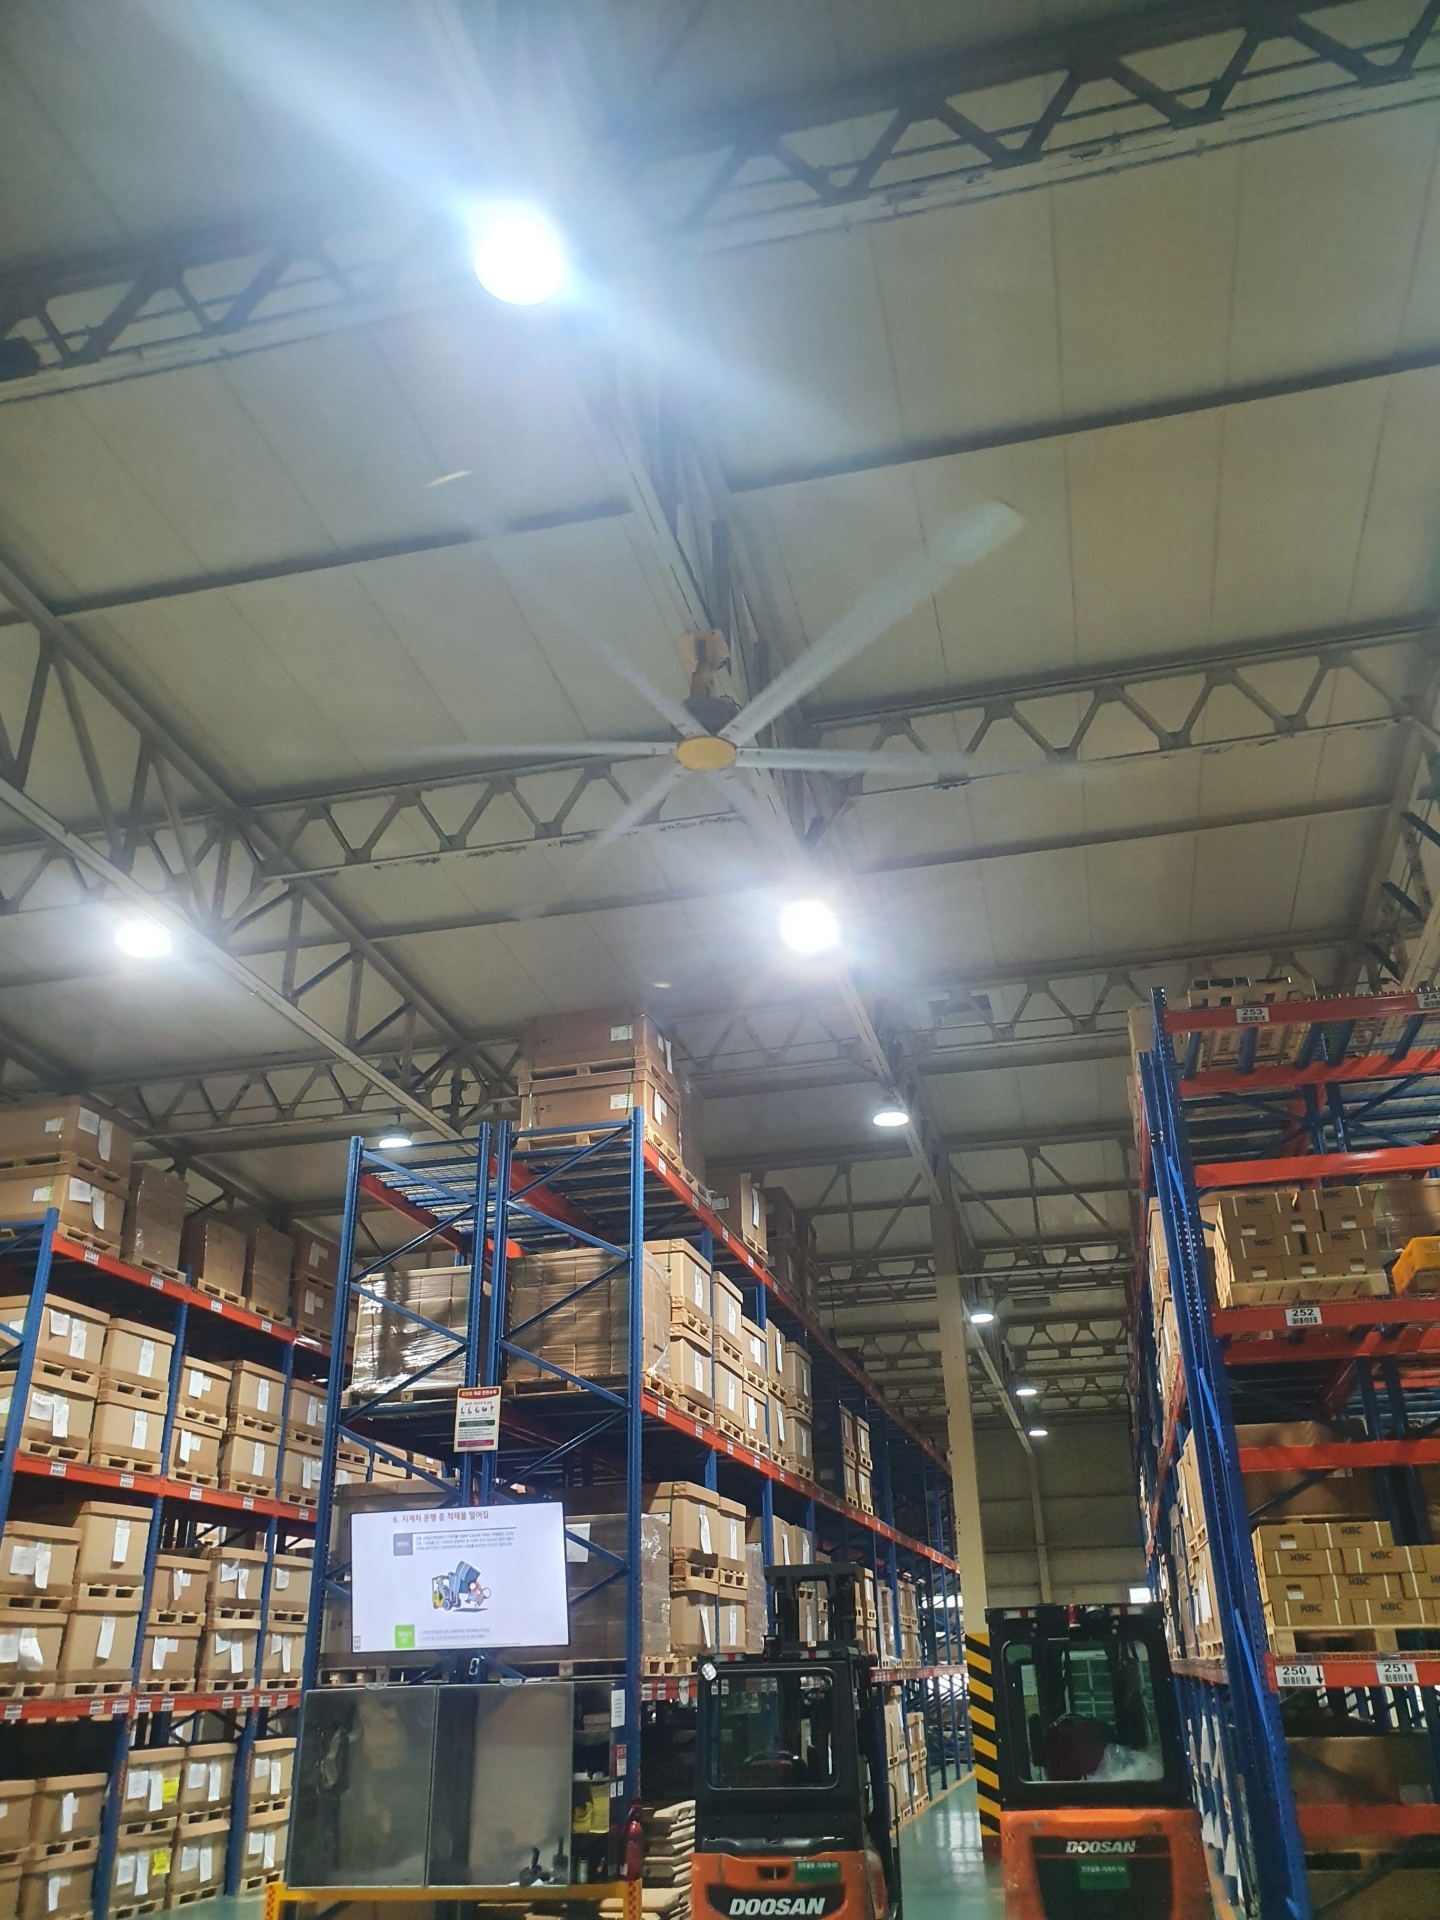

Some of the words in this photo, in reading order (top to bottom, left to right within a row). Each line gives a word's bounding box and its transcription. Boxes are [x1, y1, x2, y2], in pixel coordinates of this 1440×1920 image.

[1242, 1008, 1263, 1016] 253
[1331, 1233, 1351, 1241] KBC
[1254, 1238, 1274, 1246] KBC
[1291, 1308, 1314, 1317] 252
[393, 1515, 400, 1524] 6.
[401, 1513, 422, 1523] 지게차
[423, 1512, 437, 1523] 운행
[438, 1512, 445, 1522] 중
[447, 1511, 467, 1521] 적재물
[468, 1510, 489, 1520] 떨어짐
[1340, 1526, 1362, 1535] KBC
[1290, 1553, 1312, 1562] KBC
[1370, 1551, 1392, 1560] KBC
[1348, 1577, 1370, 1586] KBC
[1300, 1604, 1322, 1613] KBC
[1380, 1602, 1403, 1611] KBC
[1282, 1666, 1307, 1676] 250
[1384, 1663, 1408, 1673] 251
[1065, 1840, 1136, 1854] DOOSAN
[728, 1897, 826, 1916] DOOSAN
